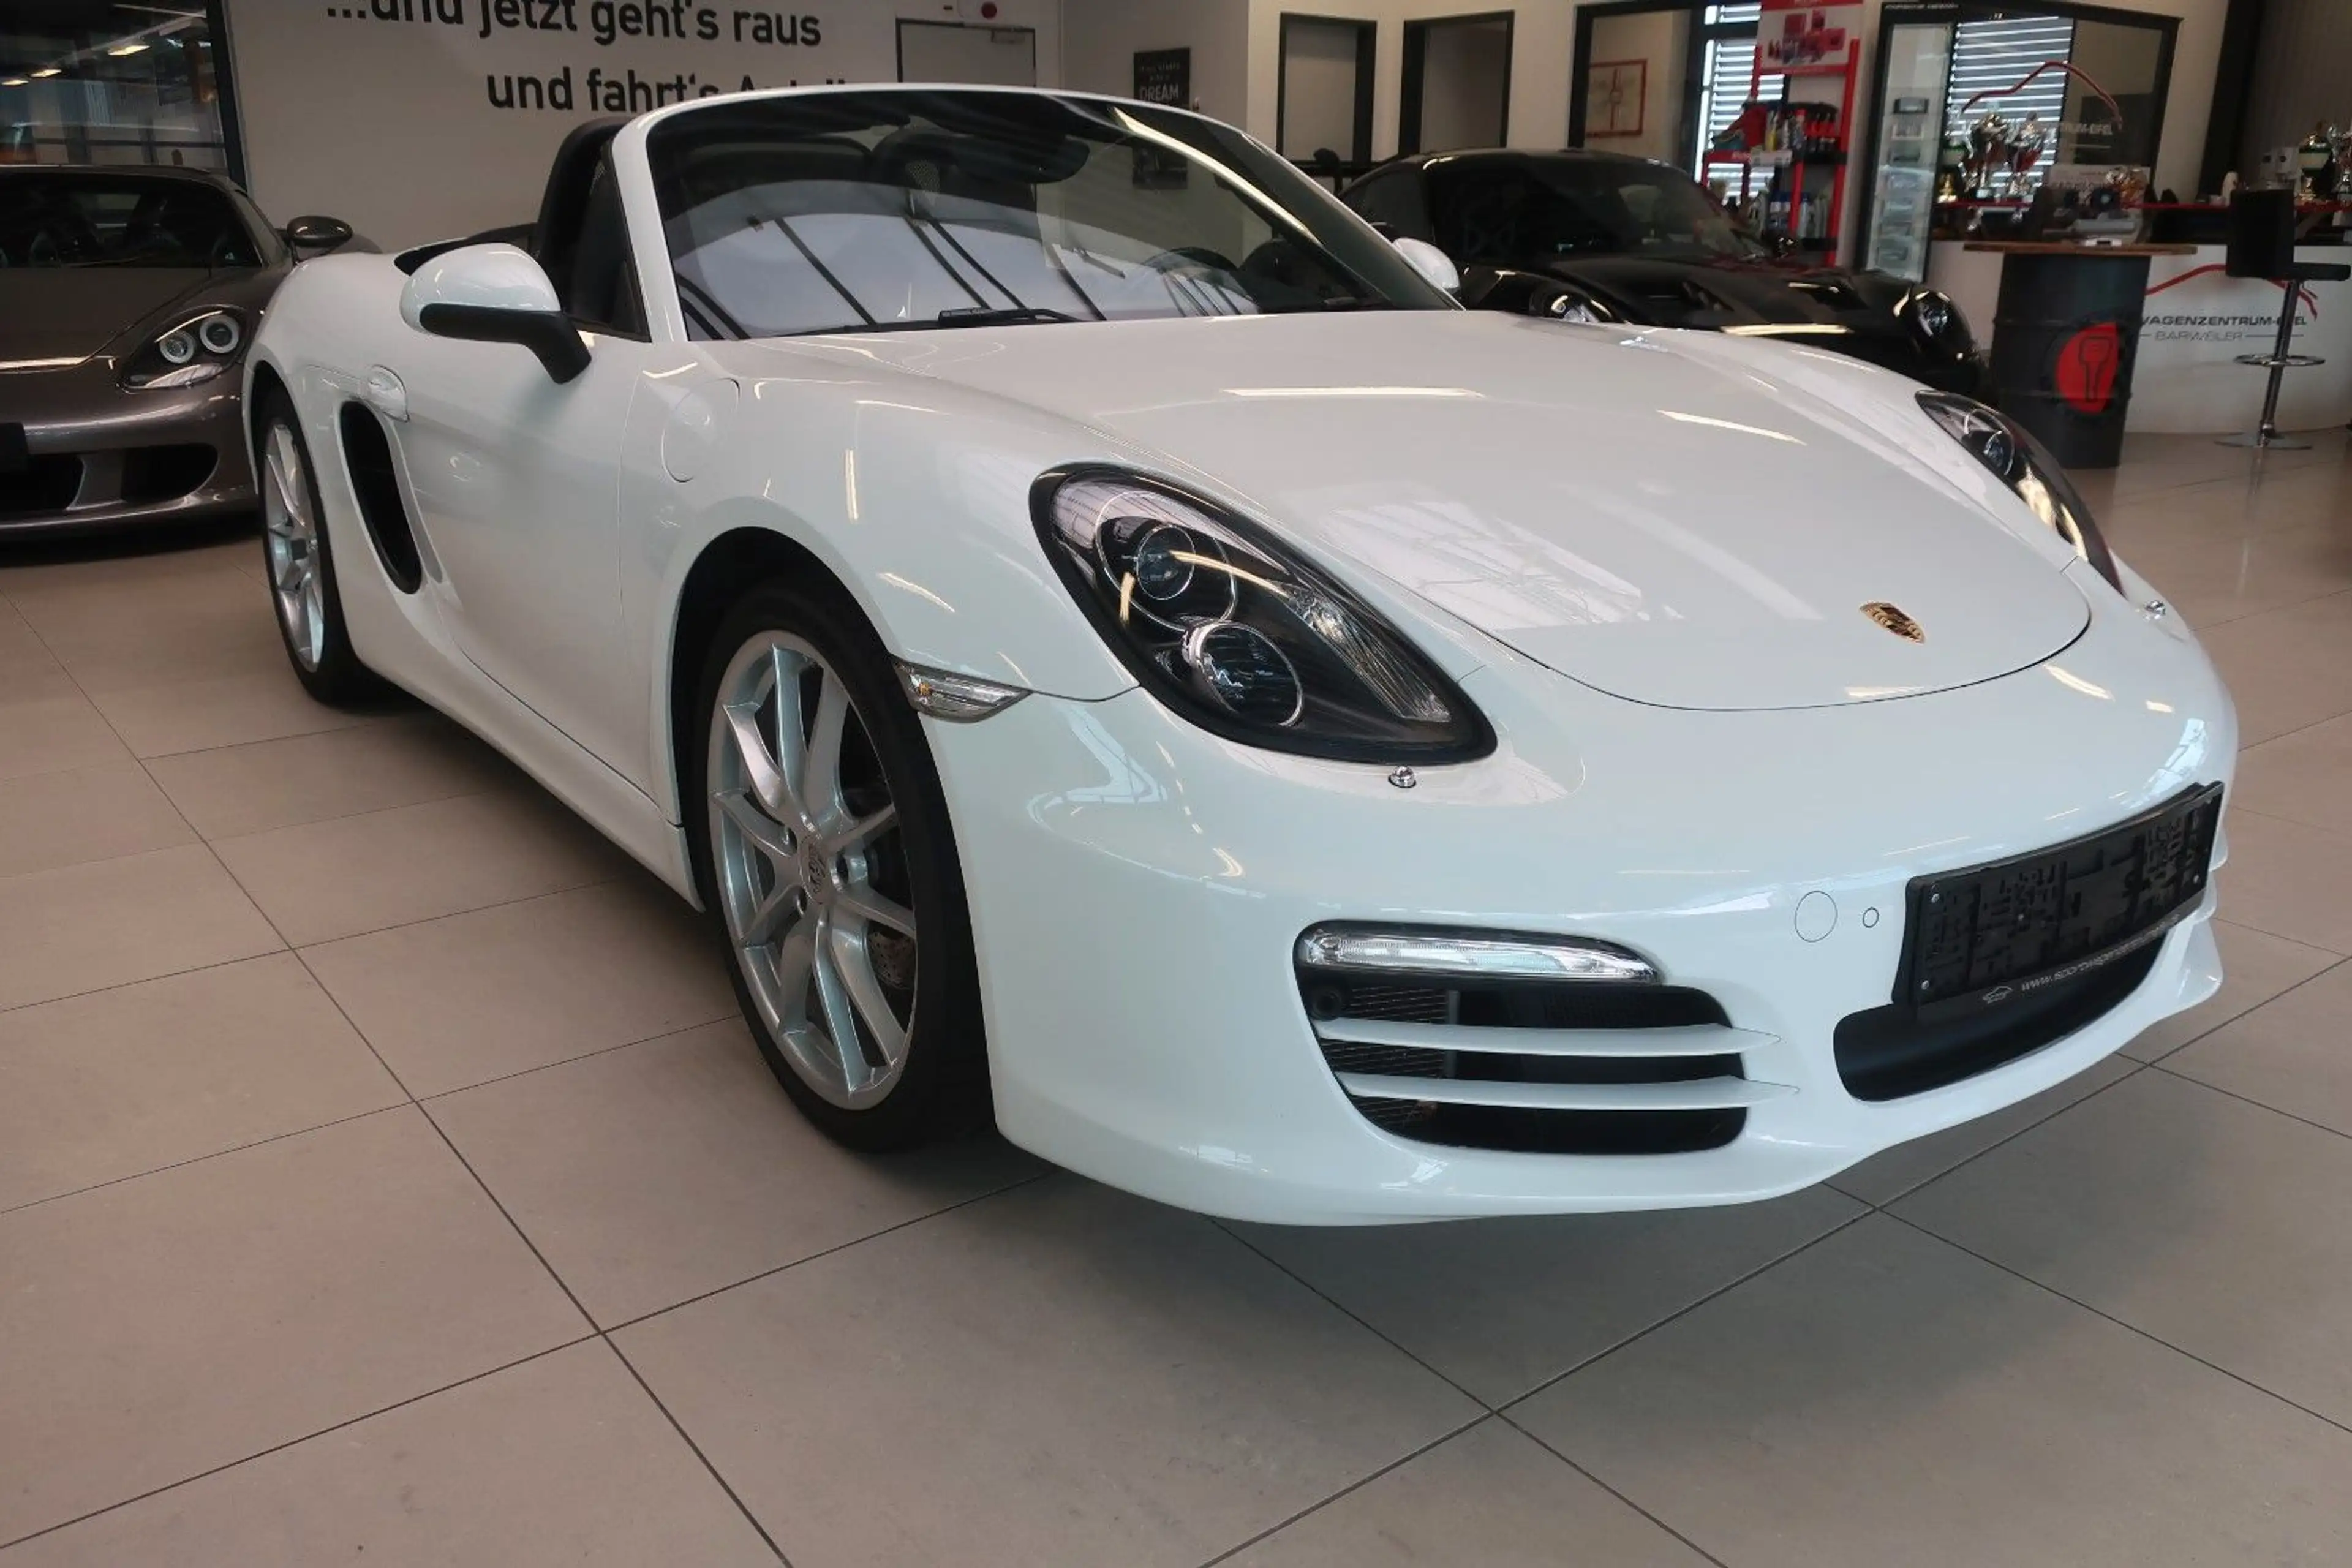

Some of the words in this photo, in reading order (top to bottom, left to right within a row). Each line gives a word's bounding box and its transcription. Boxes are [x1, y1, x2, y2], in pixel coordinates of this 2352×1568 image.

[479, 0, 577, 39] jetzt
[733, 9, 822, 47] raus
[487, 66, 573, 111] und
[1139, 83, 1179, 102] DREAM
